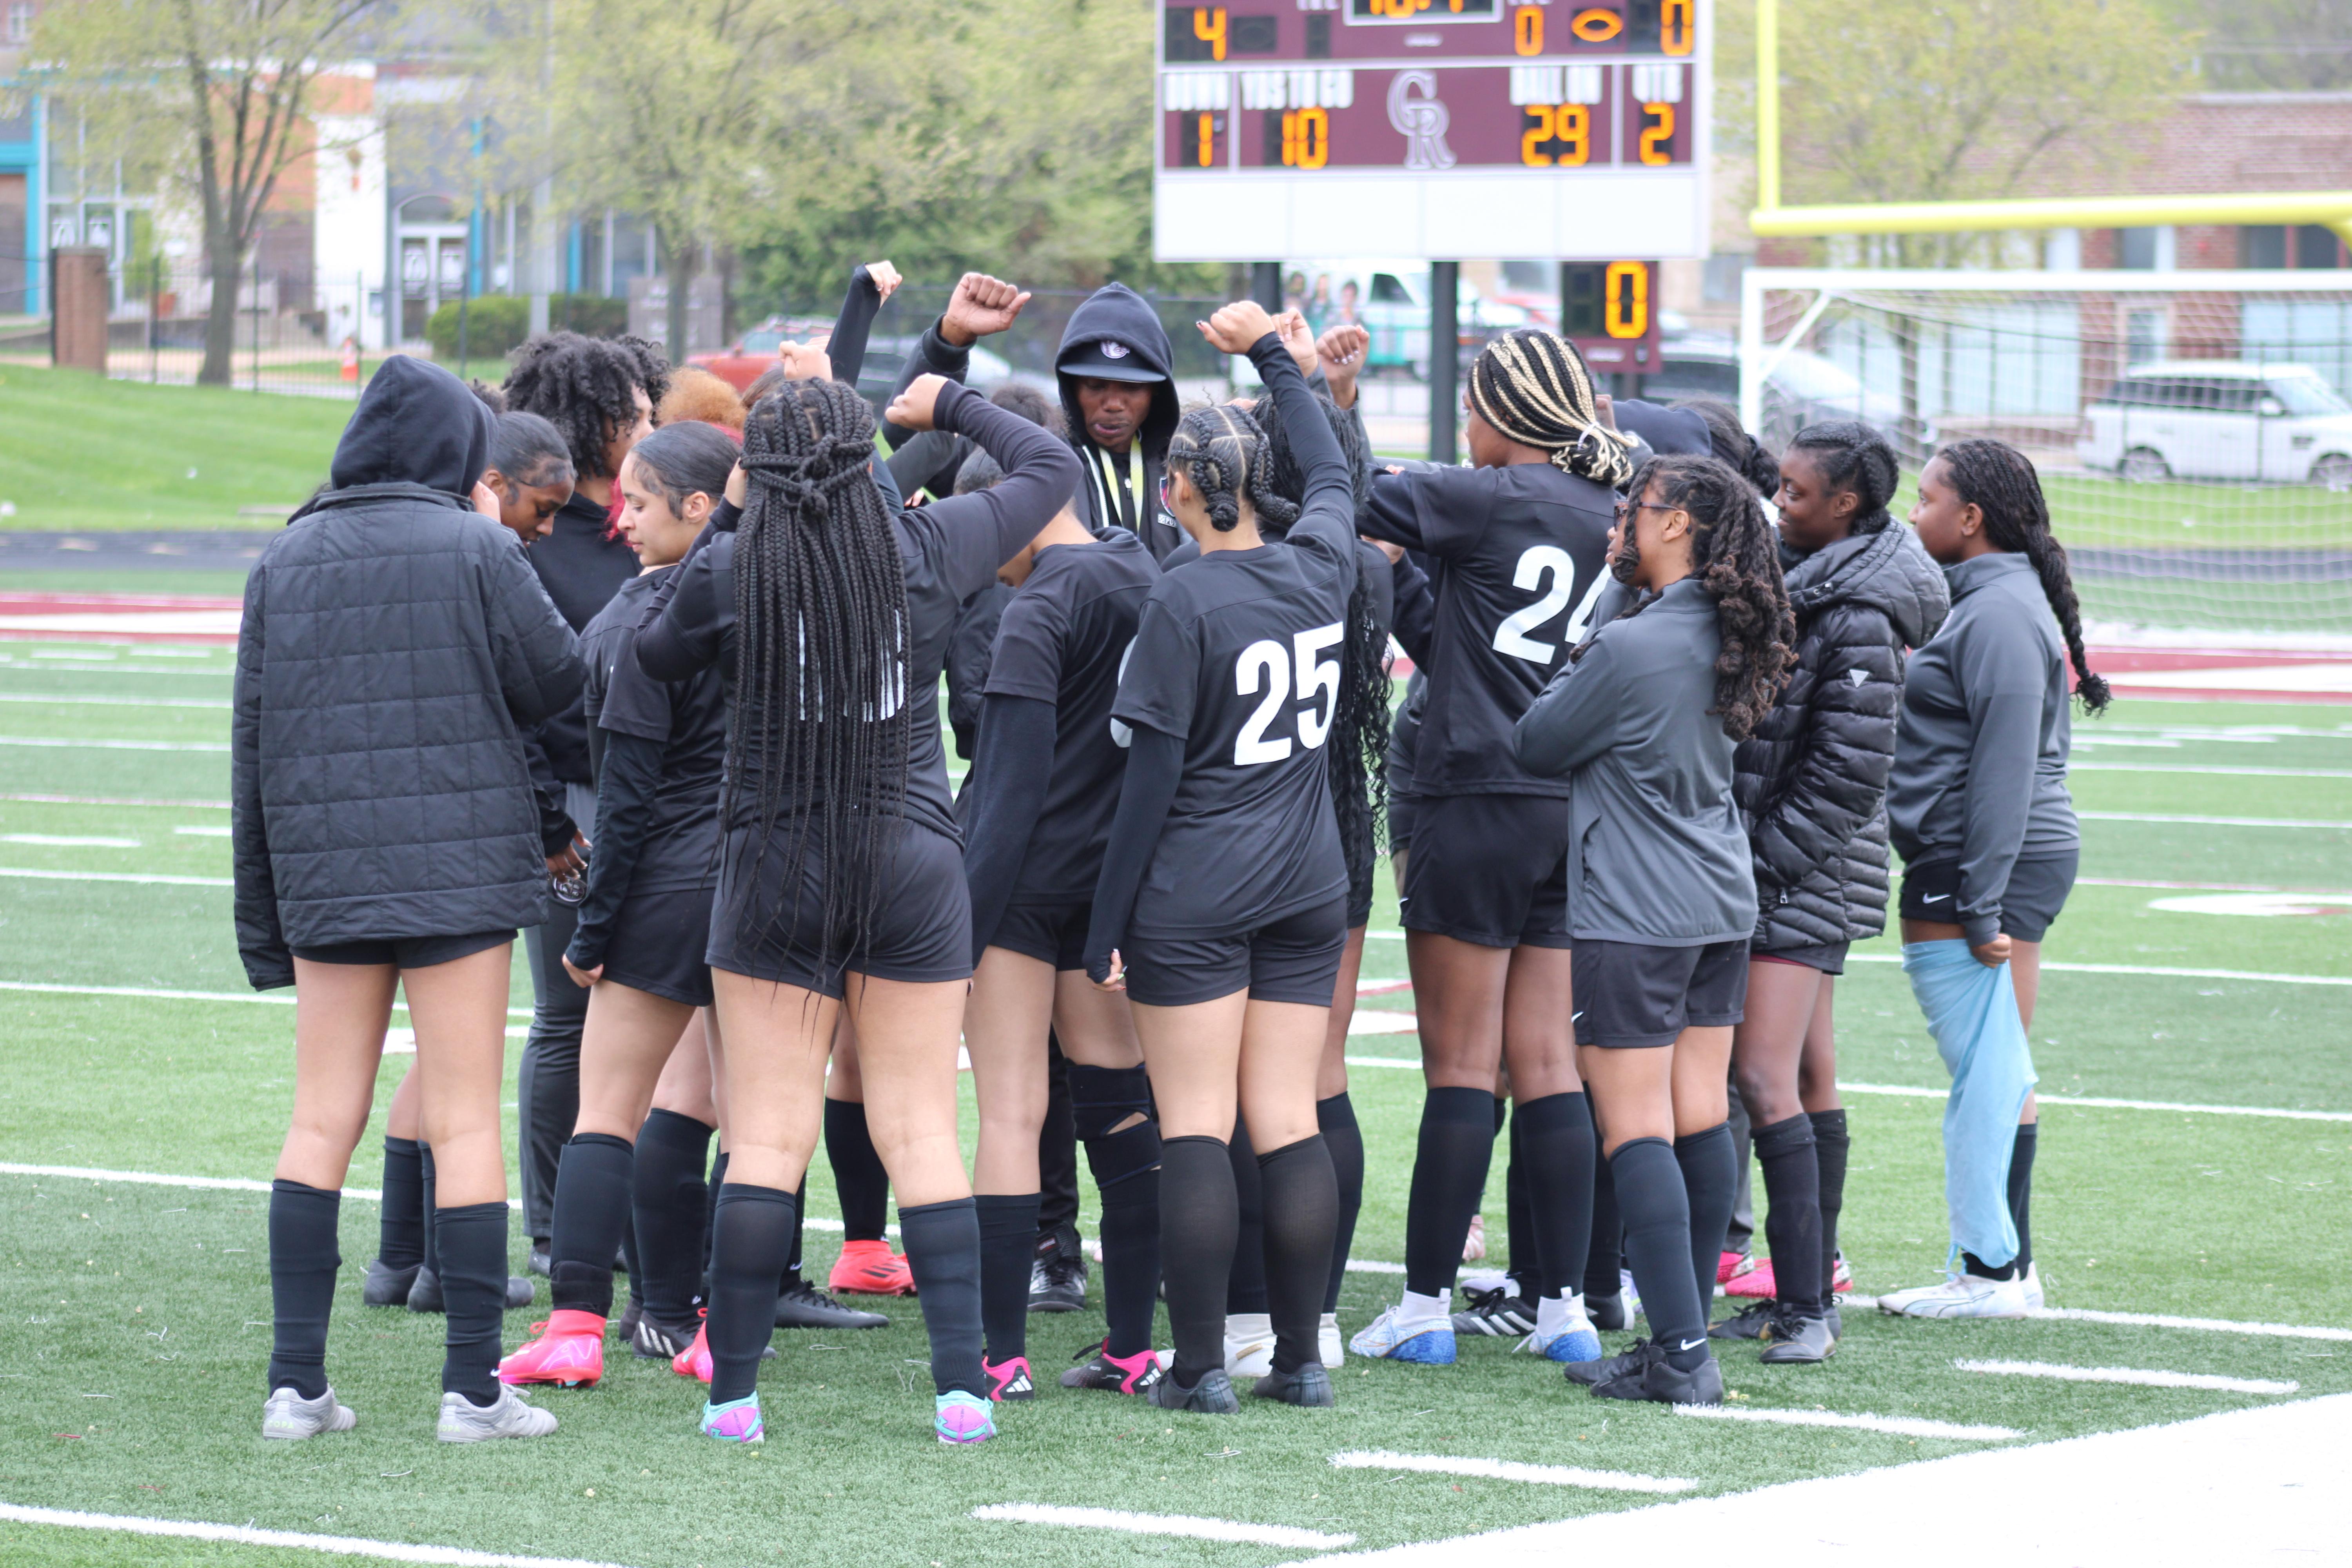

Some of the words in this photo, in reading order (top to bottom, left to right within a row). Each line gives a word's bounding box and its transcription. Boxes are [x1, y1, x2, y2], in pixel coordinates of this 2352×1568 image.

[1194, 7, 1227, 61] 4
[1515, 5, 1544, 56] 0
[1660, 0, 1694, 56] 0
[1199, 112, 1213, 167] 1
[1282, 106, 1328, 170] 10
[1521, 104, 1590, 167] 29
[1639, 102, 1674, 167] 2
[1605, 260, 1648, 339] 0
[1234, 621, 1344, 766] 25
